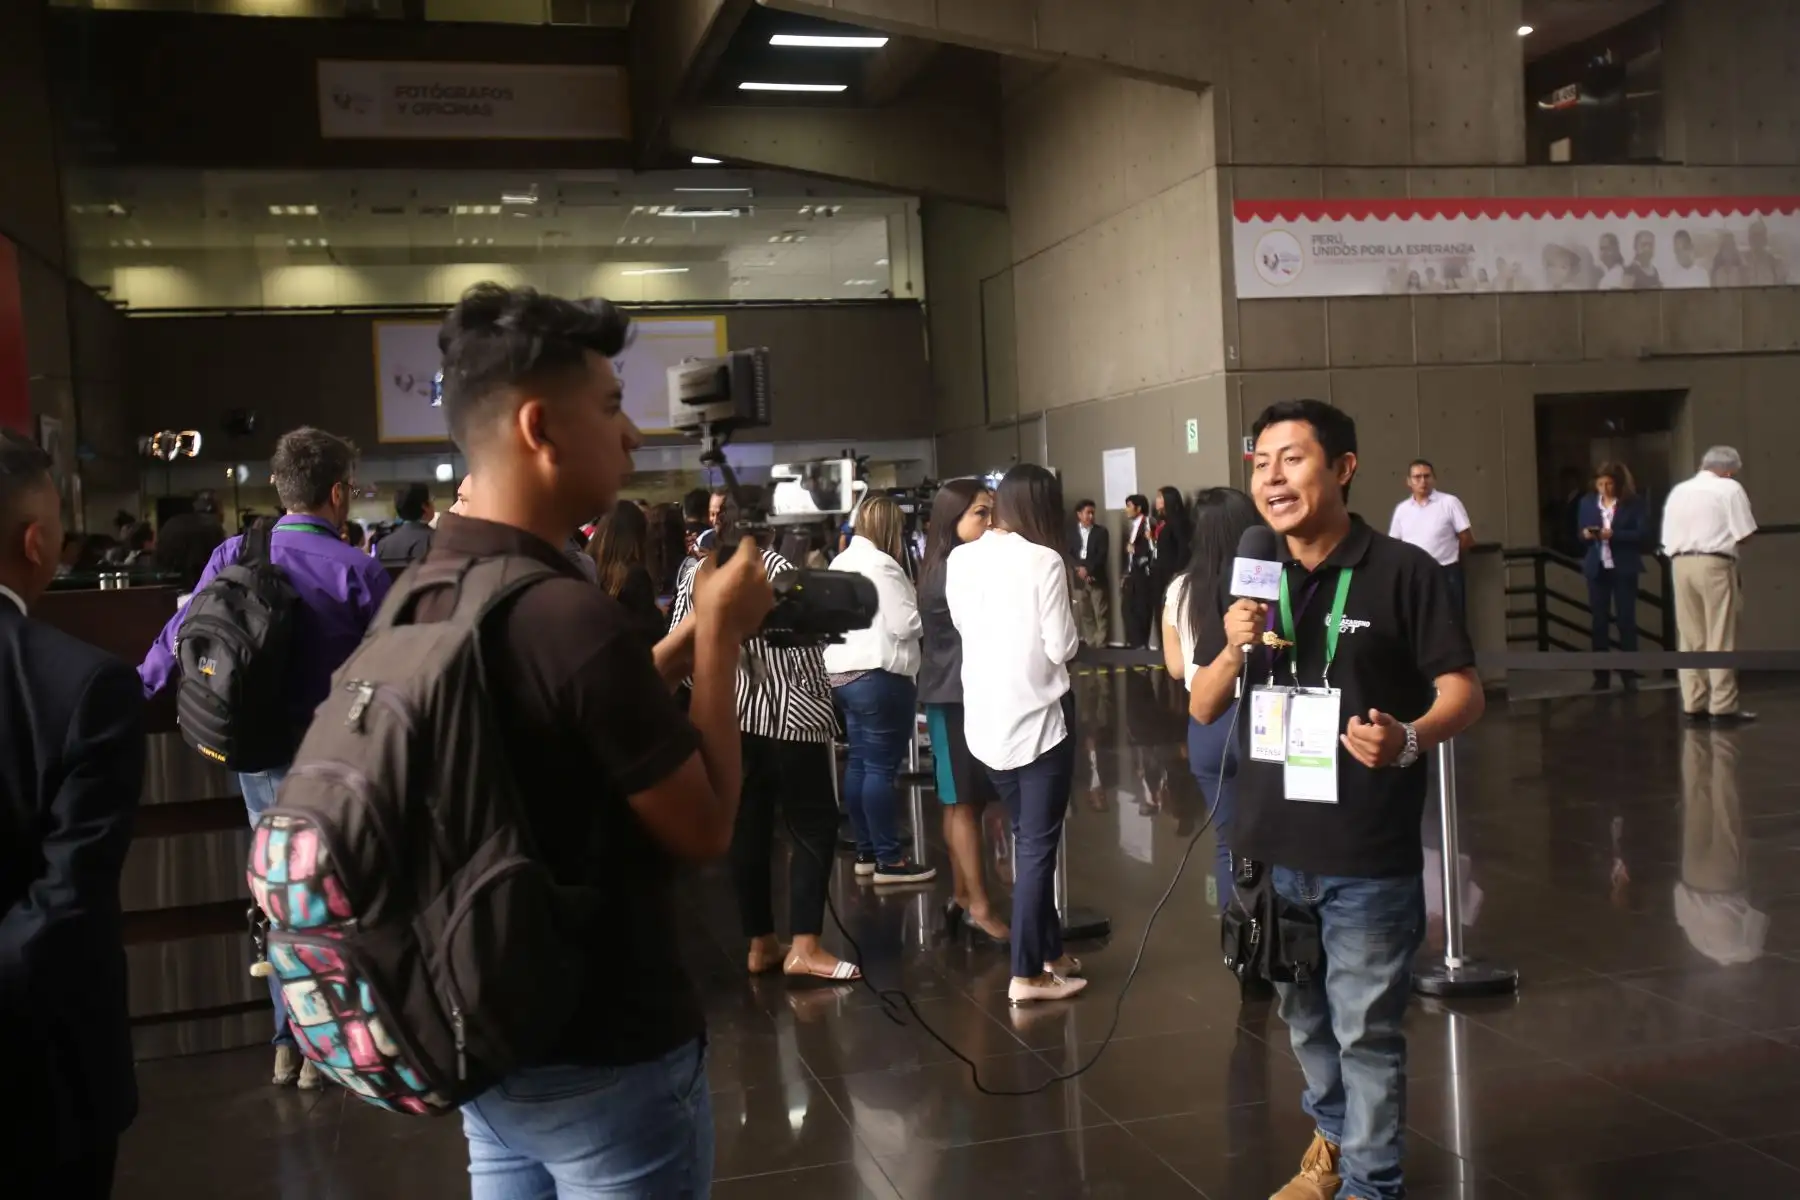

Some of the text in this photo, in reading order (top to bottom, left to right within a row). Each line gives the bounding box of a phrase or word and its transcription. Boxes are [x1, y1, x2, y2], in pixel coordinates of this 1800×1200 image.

[395, 82, 513, 101] FOTÓGRAFOS
[396, 102, 492, 116] Y OFICINAS
[1312, 242, 1476, 256] UNIDOS POR LA ESPERANZA
[1189, 423, 1196, 439] S
[198, 656, 217, 676] CAT
